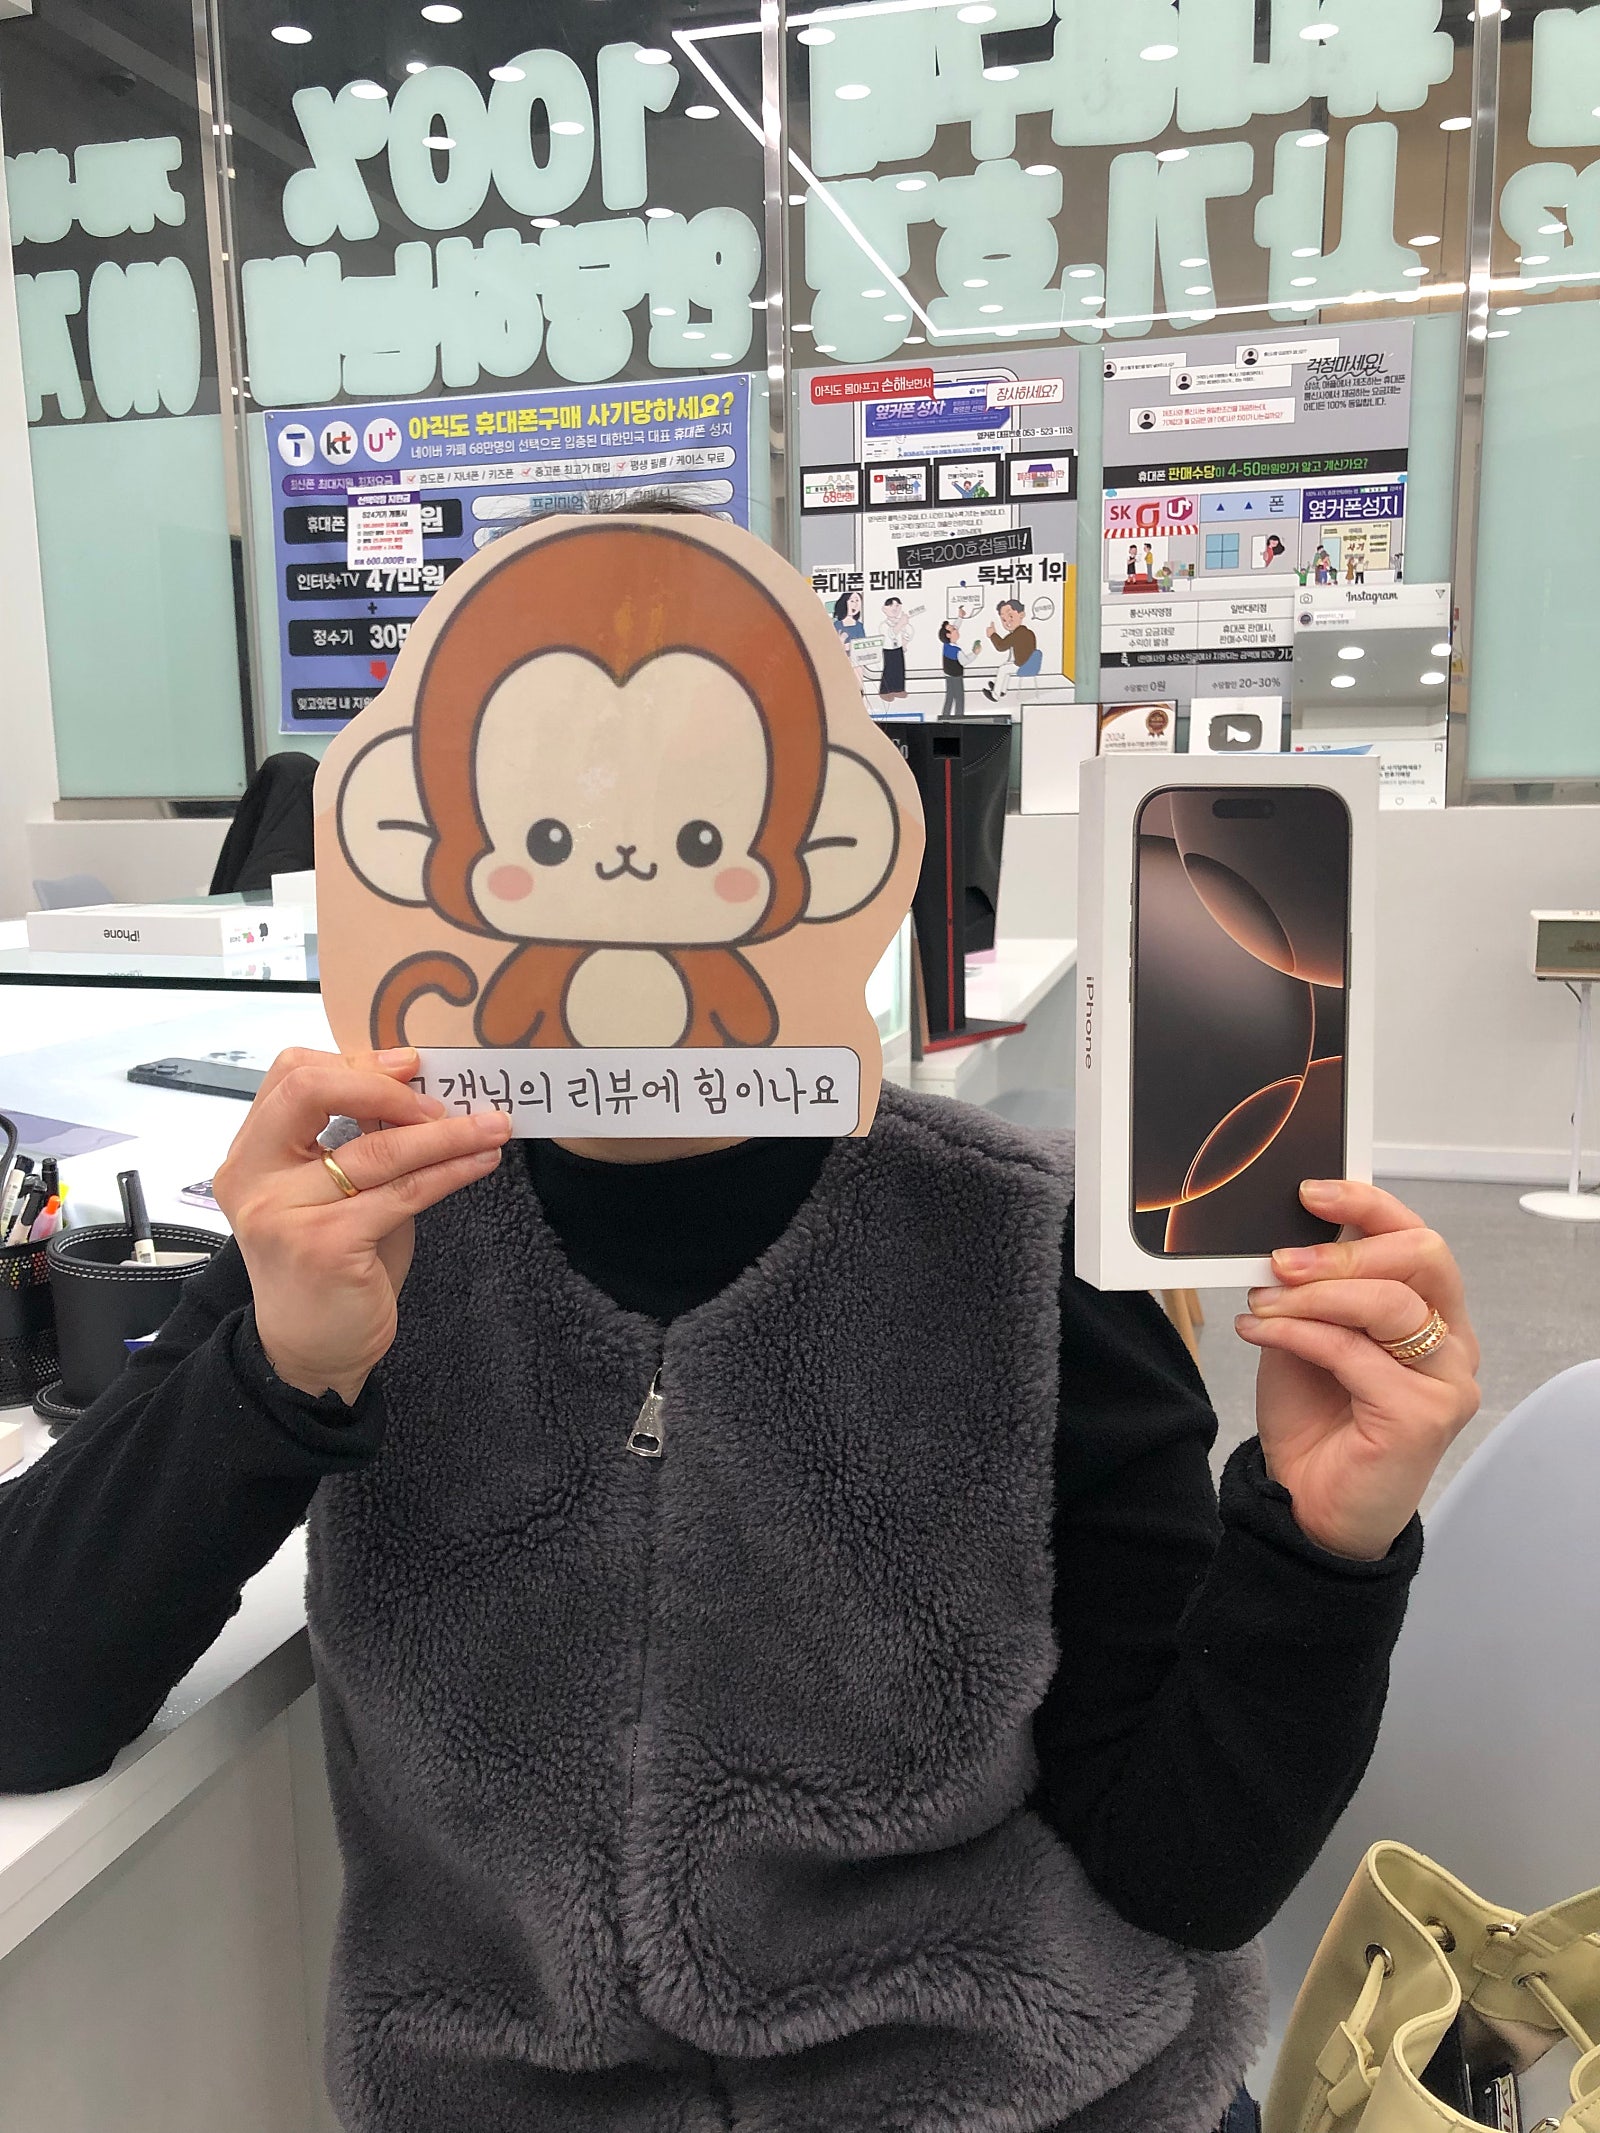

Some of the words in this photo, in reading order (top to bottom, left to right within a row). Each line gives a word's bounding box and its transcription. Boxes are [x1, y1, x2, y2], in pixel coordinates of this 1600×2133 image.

[1307, 353, 1385, 374] 걱정마세요!
[815, 384, 842, 397] 아직도
[845, 381, 879, 395] 몸아프고
[881, 376, 932, 393] 손해보면서
[1353, 376, 1382, 387] 제조하는
[1384, 374, 1406, 384] 휴대폰
[997, 384, 1058, 402] 장사하세요?
[1341, 388, 1370, 398] 제공하는
[1372, 385, 1401, 396] 요금제는
[1303, 401, 1325, 411] 어디든
[1327, 400, 1347, 410] 100%
[409, 413, 470, 440] 아직도
[475, 405, 582, 436] 휴대폰구매
[587, 392, 735, 427] 사기당하세요?
[326, 431, 351, 456] kt
[369, 428, 397, 453] U+
[411, 444, 443, 460] 네이버
[445, 442, 467, 457] 카페
[469, 440, 516, 455] 68만명의
[518, 437, 562, 453] 선택으로
[564, 434, 597, 449] 입증된
[600, 431, 645, 446] 대한민국
[648, 429, 671, 443] 대표
[674, 426, 707, 441] 휴대폰
[709, 422, 732, 437] 성지
[535, 466, 561, 477] 중고폰
[564, 463, 591, 475] 최고가
[593, 462, 611, 473] 매입
[630, 459, 648, 471] 평생
[650, 457, 667, 470] 필름
[676, 454, 704, 466] 케이스
[707, 452, 725, 464] 무료
[1137, 470, 1166, 483] 휴대폰
[1301, 459, 1321, 472] 알고
[1324, 457, 1369, 471] 계신가요?
[419, 473, 445, 484] 효도폰
[453, 471, 480, 483] 자녀폰
[488, 469, 514, 480] 키즈폰
[1110, 505, 1131, 520] SK
[1269, 494, 1285, 513] 폰
[1308, 495, 1398, 520] 옆커폰성지
[307, 516, 345, 534] 휴대폰
[906, 532, 1028, 566] 전국200호점돌파!
[297, 572, 360, 591] 인터넷+TV
[366, 565, 445, 592] 47만원
[977, 565, 1032, 585] 독보적
[1038, 558, 1067, 583] 1위
[812, 572, 864, 593] 휴대폰
[869, 569, 922, 591] 판매점
[1346, 591, 1398, 605] Instagram
[1130, 608, 1173, 618] 통신사직영점
[1230, 603, 1268, 614] 일반대리점
[313, 629, 353, 647] 정수기
[1120, 628, 1143, 638] 고객의
[1145, 627, 1175, 637] 요금제로
[1223, 624, 1246, 634] 휴대폰
[1128, 638, 1152, 648] 수익이
[1153, 637, 1169, 647] 발생
[1219, 635, 1258, 645] 판매수익이
[1260, 633, 1276, 643] 발생
[1150, 680, 1166, 691] 0원
[1239, 677, 1281, 688] 20~30%
[339, 697, 351, 710] 내
[104, 928, 140, 942] iPhone
[1085, 976, 1094, 1069] iPhone
[412, 1068, 551, 1116] 객님의
[567, 1067, 681, 1116] 리뷰에
[693, 1066, 840, 1116] 힘이나요
